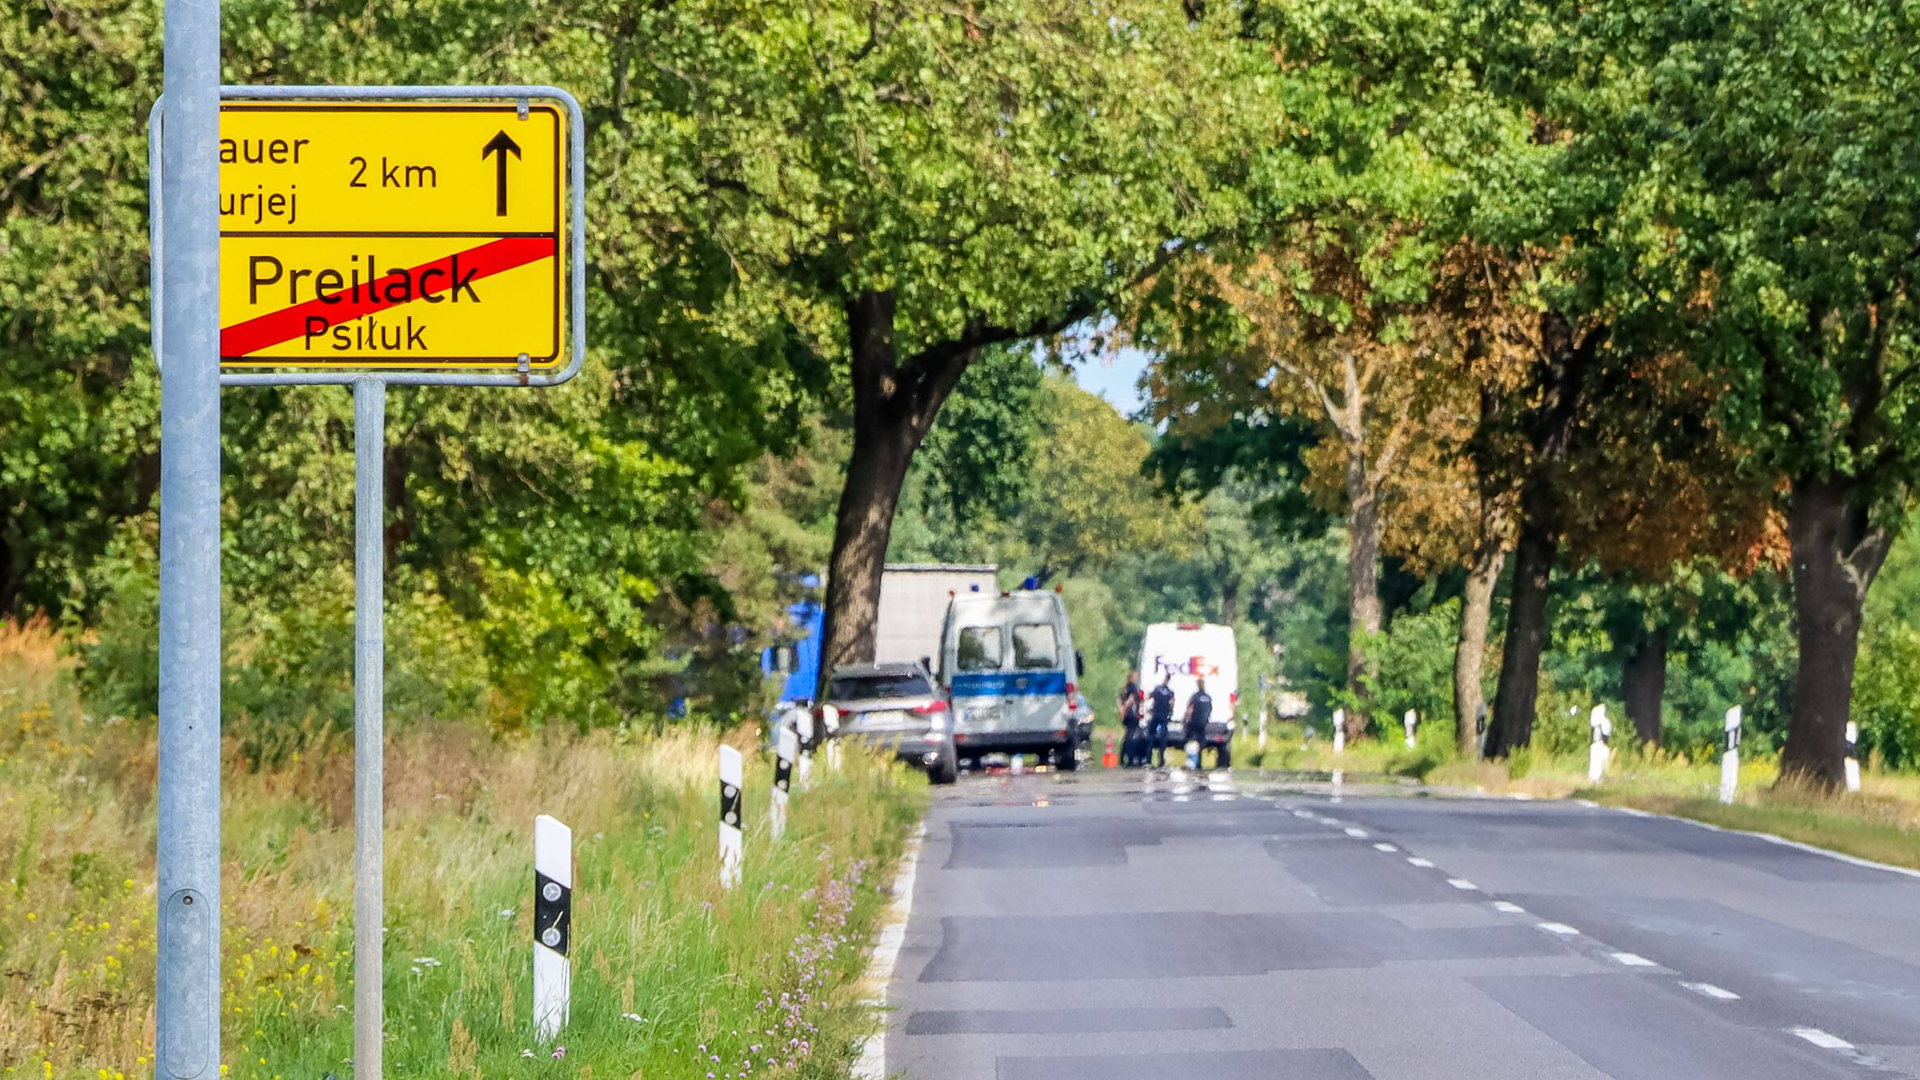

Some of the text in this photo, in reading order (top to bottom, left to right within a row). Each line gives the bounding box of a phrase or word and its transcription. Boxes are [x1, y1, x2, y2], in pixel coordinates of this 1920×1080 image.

[219, 138, 310, 164] auer
[349, 156, 437, 188] 2 km
[219, 184, 297, 225] urjej
[249, 254, 481, 305] Preilack
[304, 315, 428, 351] Psiłuk
[1155, 654, 1219, 677] FedEx
